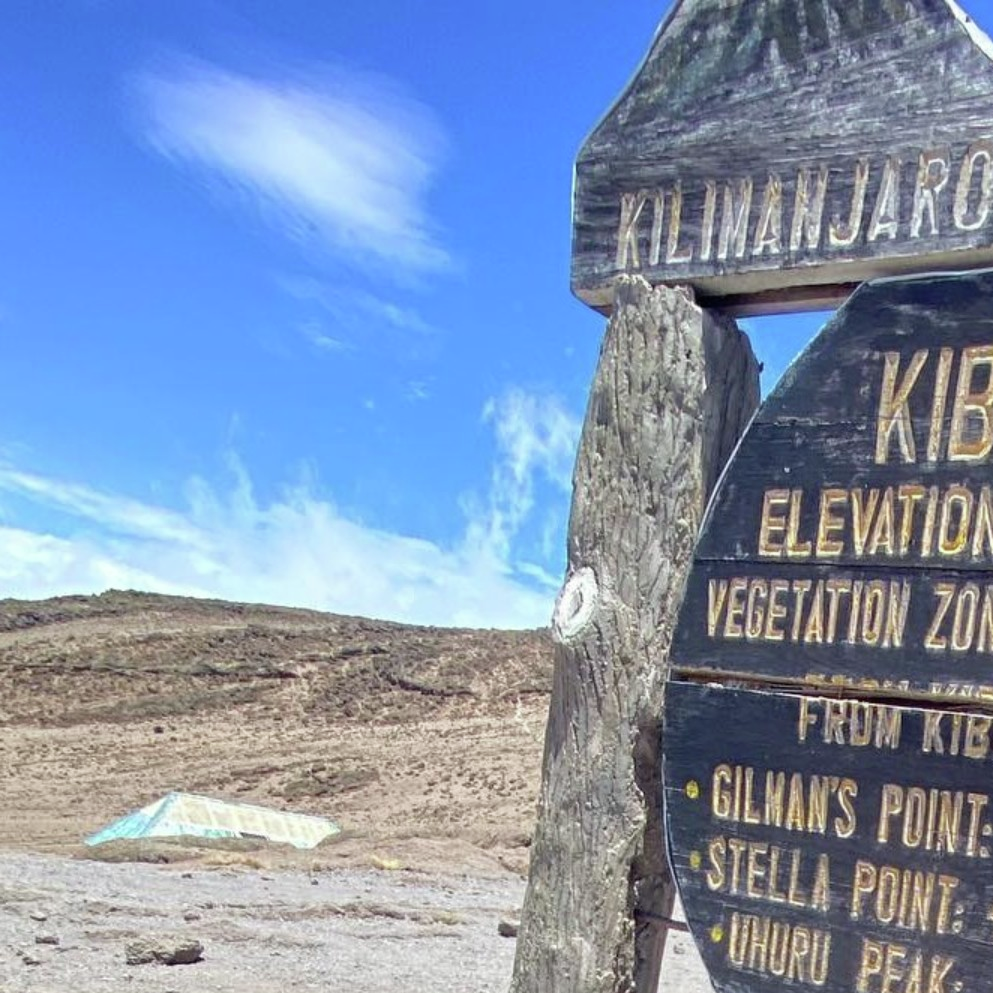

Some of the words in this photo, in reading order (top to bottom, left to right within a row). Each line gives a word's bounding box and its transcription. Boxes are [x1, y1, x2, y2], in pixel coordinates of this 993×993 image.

[705, 576, 912, 648] VEGETATION
[797, 673, 905, 750] FROM
[711, 763, 859, 840] GILMAN'S
[706, 837, 831, 914] STELLA
[850, 859, 967, 936] POINT:
[726, 910, 832, 988] UHURU
